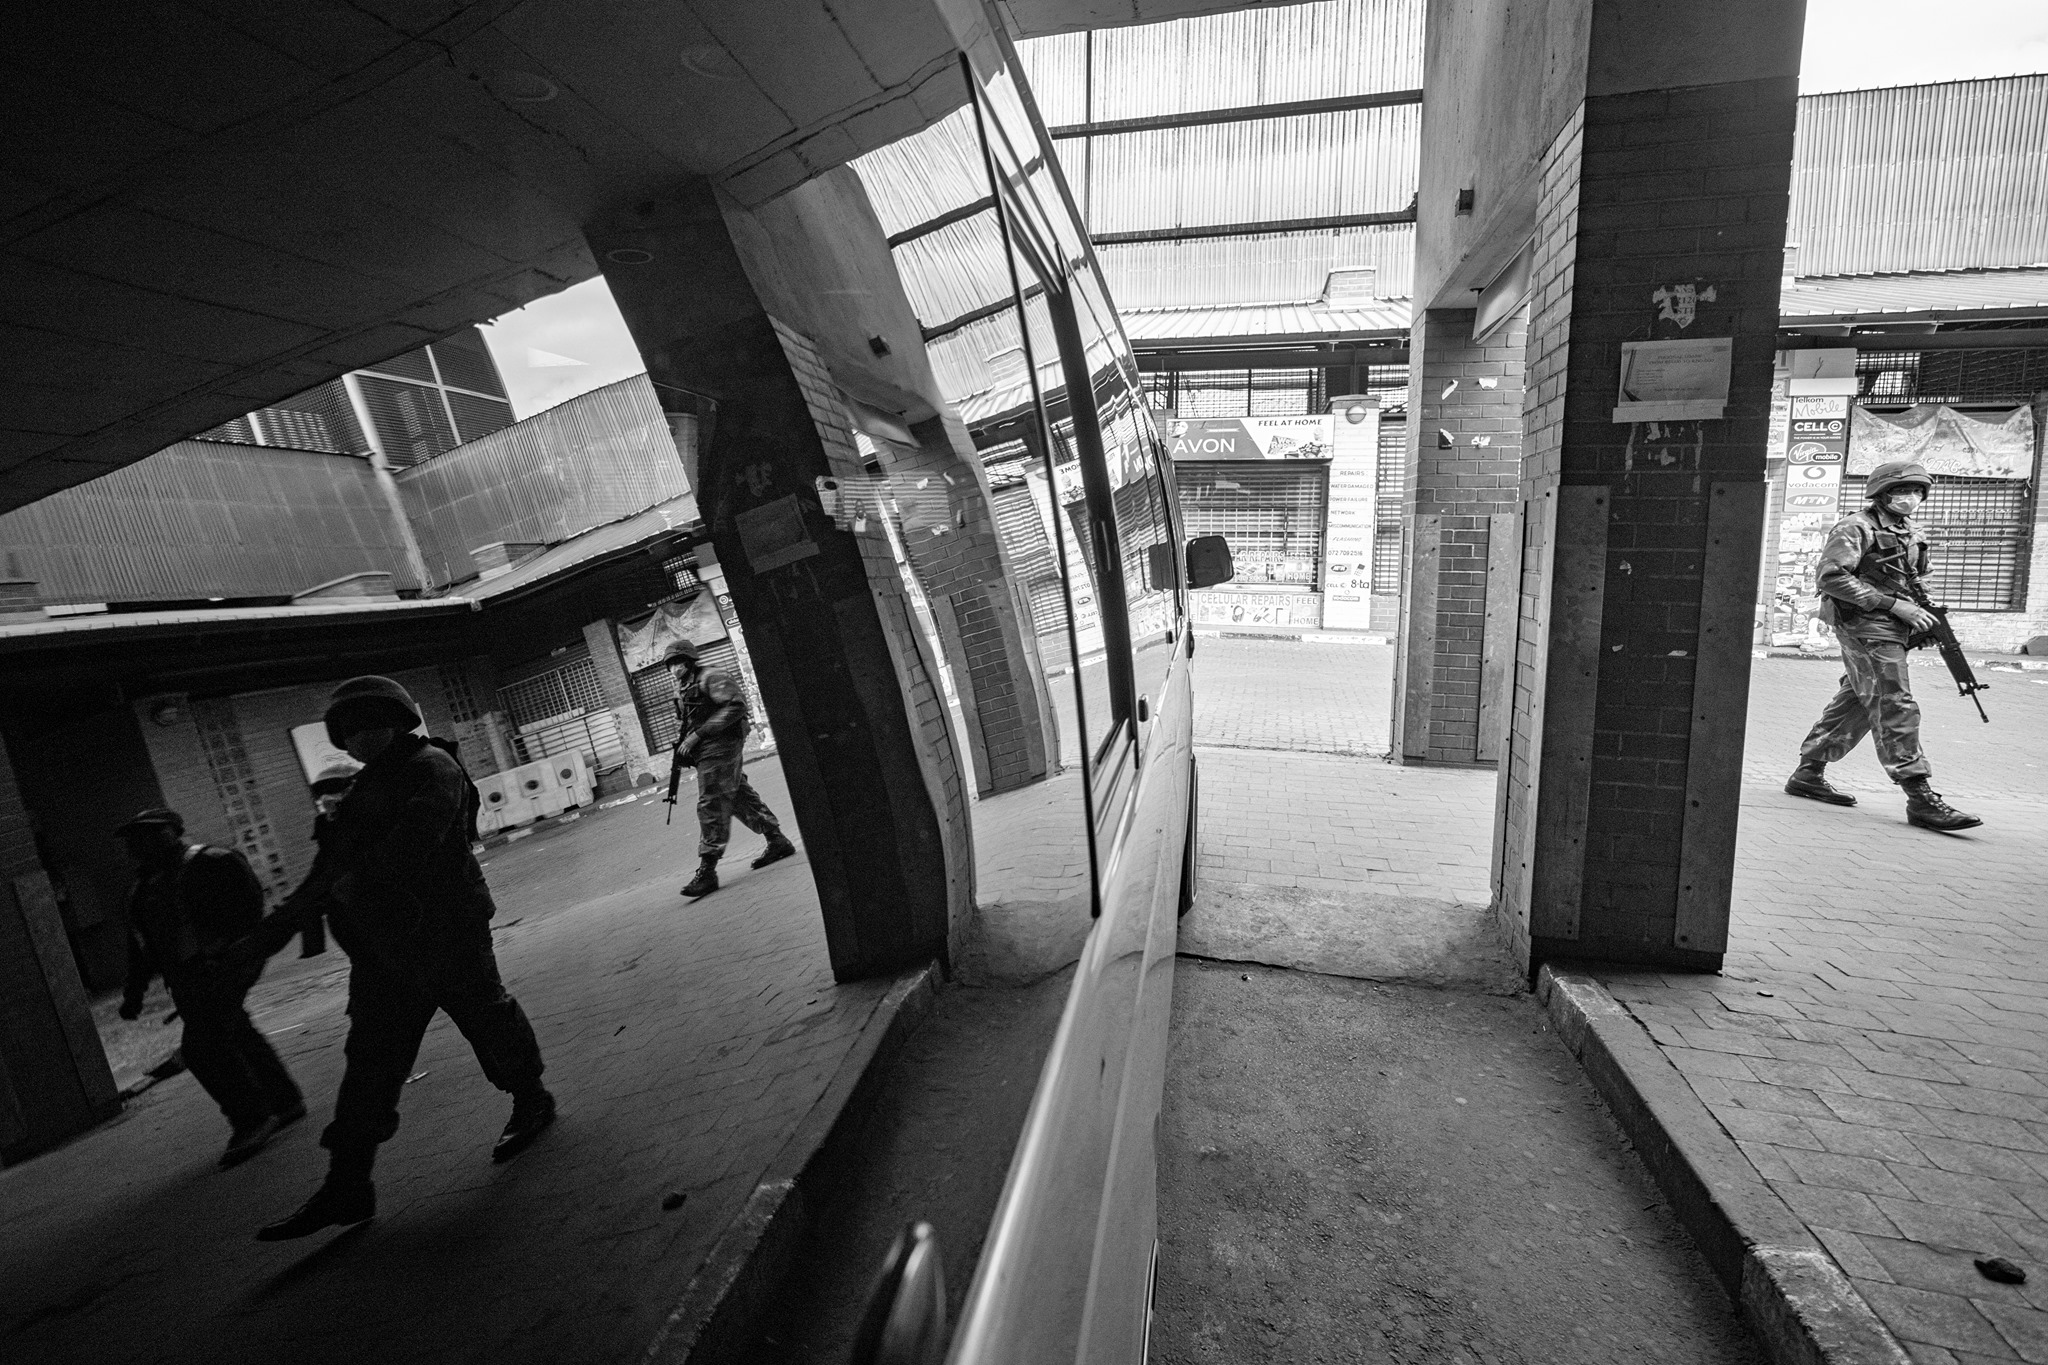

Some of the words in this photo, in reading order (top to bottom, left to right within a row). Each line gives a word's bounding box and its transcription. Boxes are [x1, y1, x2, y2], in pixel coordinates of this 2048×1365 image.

[1794, 399, 1846, 418] Mobile
[1294, 418, 1323, 426] HOME
[1172, 438, 1235, 454] AVON
[1793, 444, 1819, 461] Virgin
[1793, 496, 1830, 505] MTN
[1249, 551, 1284, 562] REPAIRS
[1200, 593, 1249, 605] CELLULAR
[1251, 595, 1291, 606] REPAIRS
[1296, 597, 1318, 605] FEEL
[1293, 617, 1320, 626] HOME
